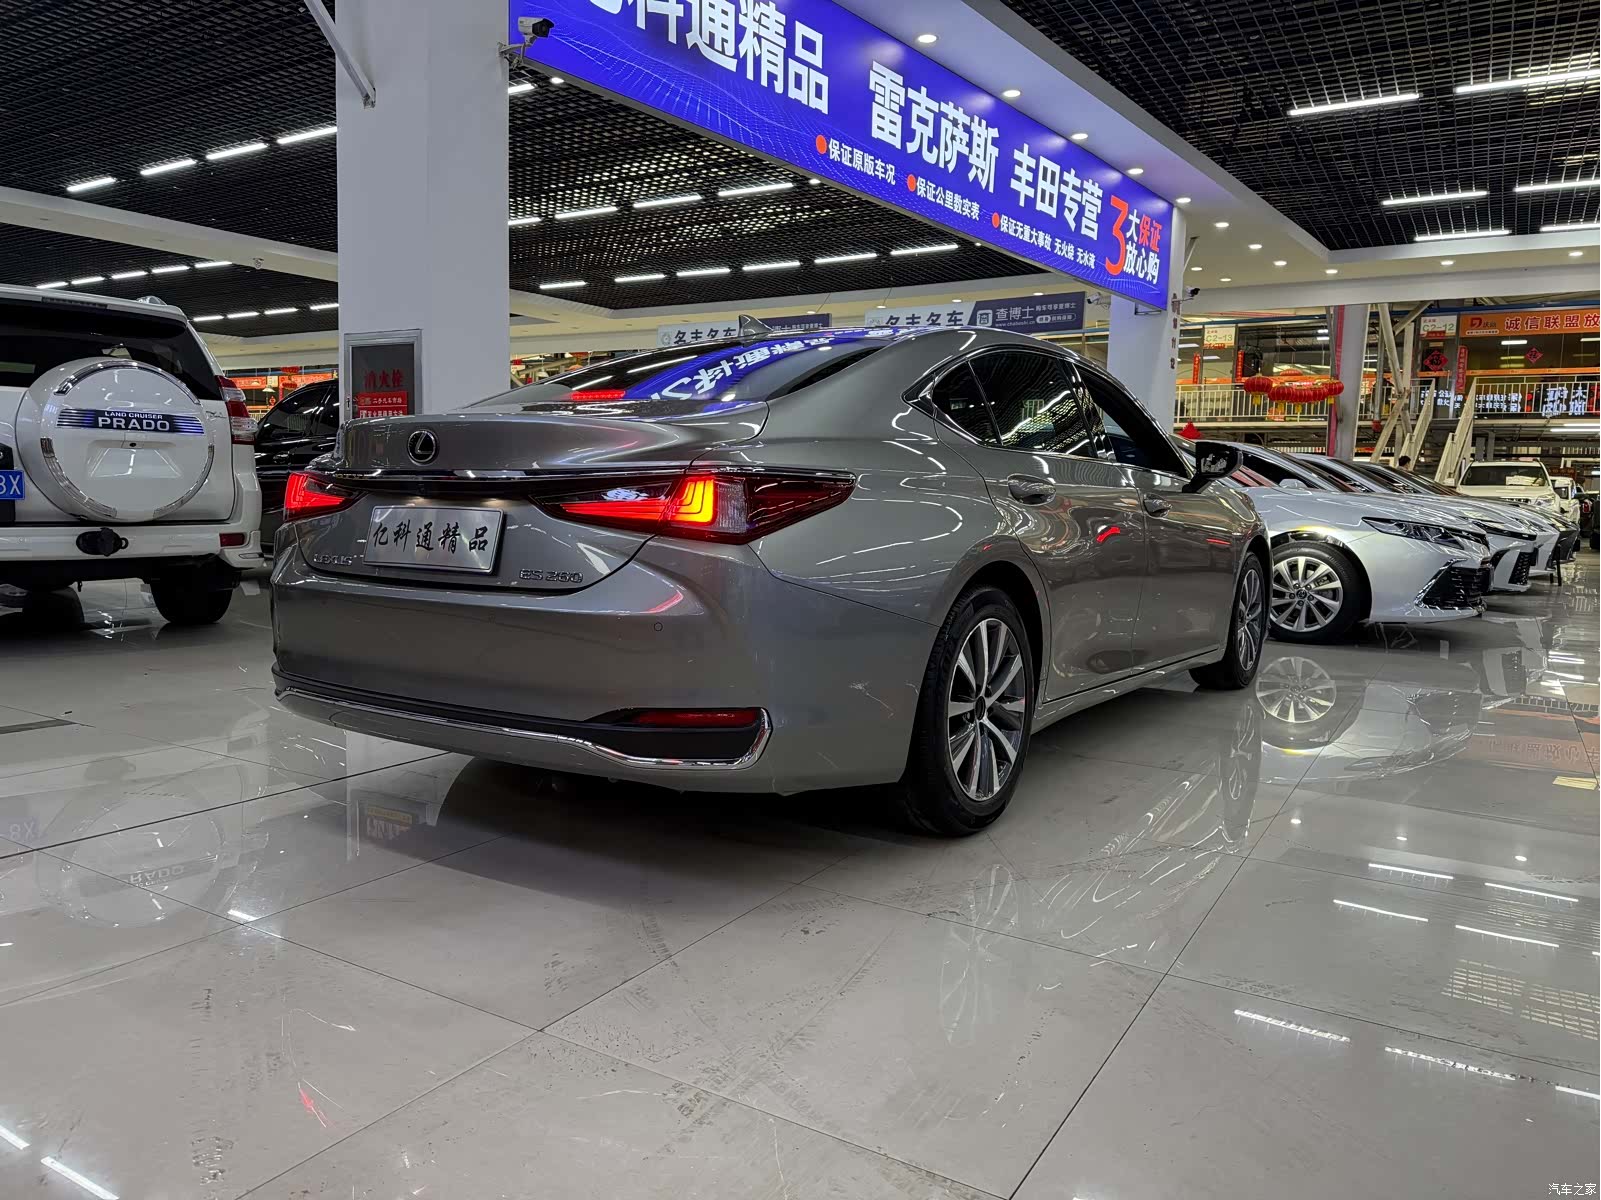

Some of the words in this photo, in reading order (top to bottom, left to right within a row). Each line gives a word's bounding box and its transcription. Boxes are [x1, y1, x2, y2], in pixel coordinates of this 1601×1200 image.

[589, 0, 828, 115] 通精品
[828, 137, 896, 186] 保证原版车况
[869, 60, 1000, 194] 雷克萨斯
[1010, 143, 1104, 241] 丰田专营
[916, 176, 980, 221] 保证公里数实表
[1000, 214, 1052, 252] 保证无重大事故
[1053, 237, 1074, 261] 无火烧
[1105, 195, 1129, 275] 3
[1123, 240, 1161, 285] 放心购
[995, 306, 1034, 322] 查博士
[1423, 323, 1455, 332] C2-12
[1504, 313, 1600, 331] 诚信联盟放
[1206, 334, 1233, 343] C2-13
[364, 369, 404, 390] 消火栓
[98, 416, 170, 431] PRADO
[128, 412, 163, 420] CRUISER
[373, 519, 489, 555] 亿科通精品
[519, 568, 543, 581] ES
[545, 570, 584, 584] 260
